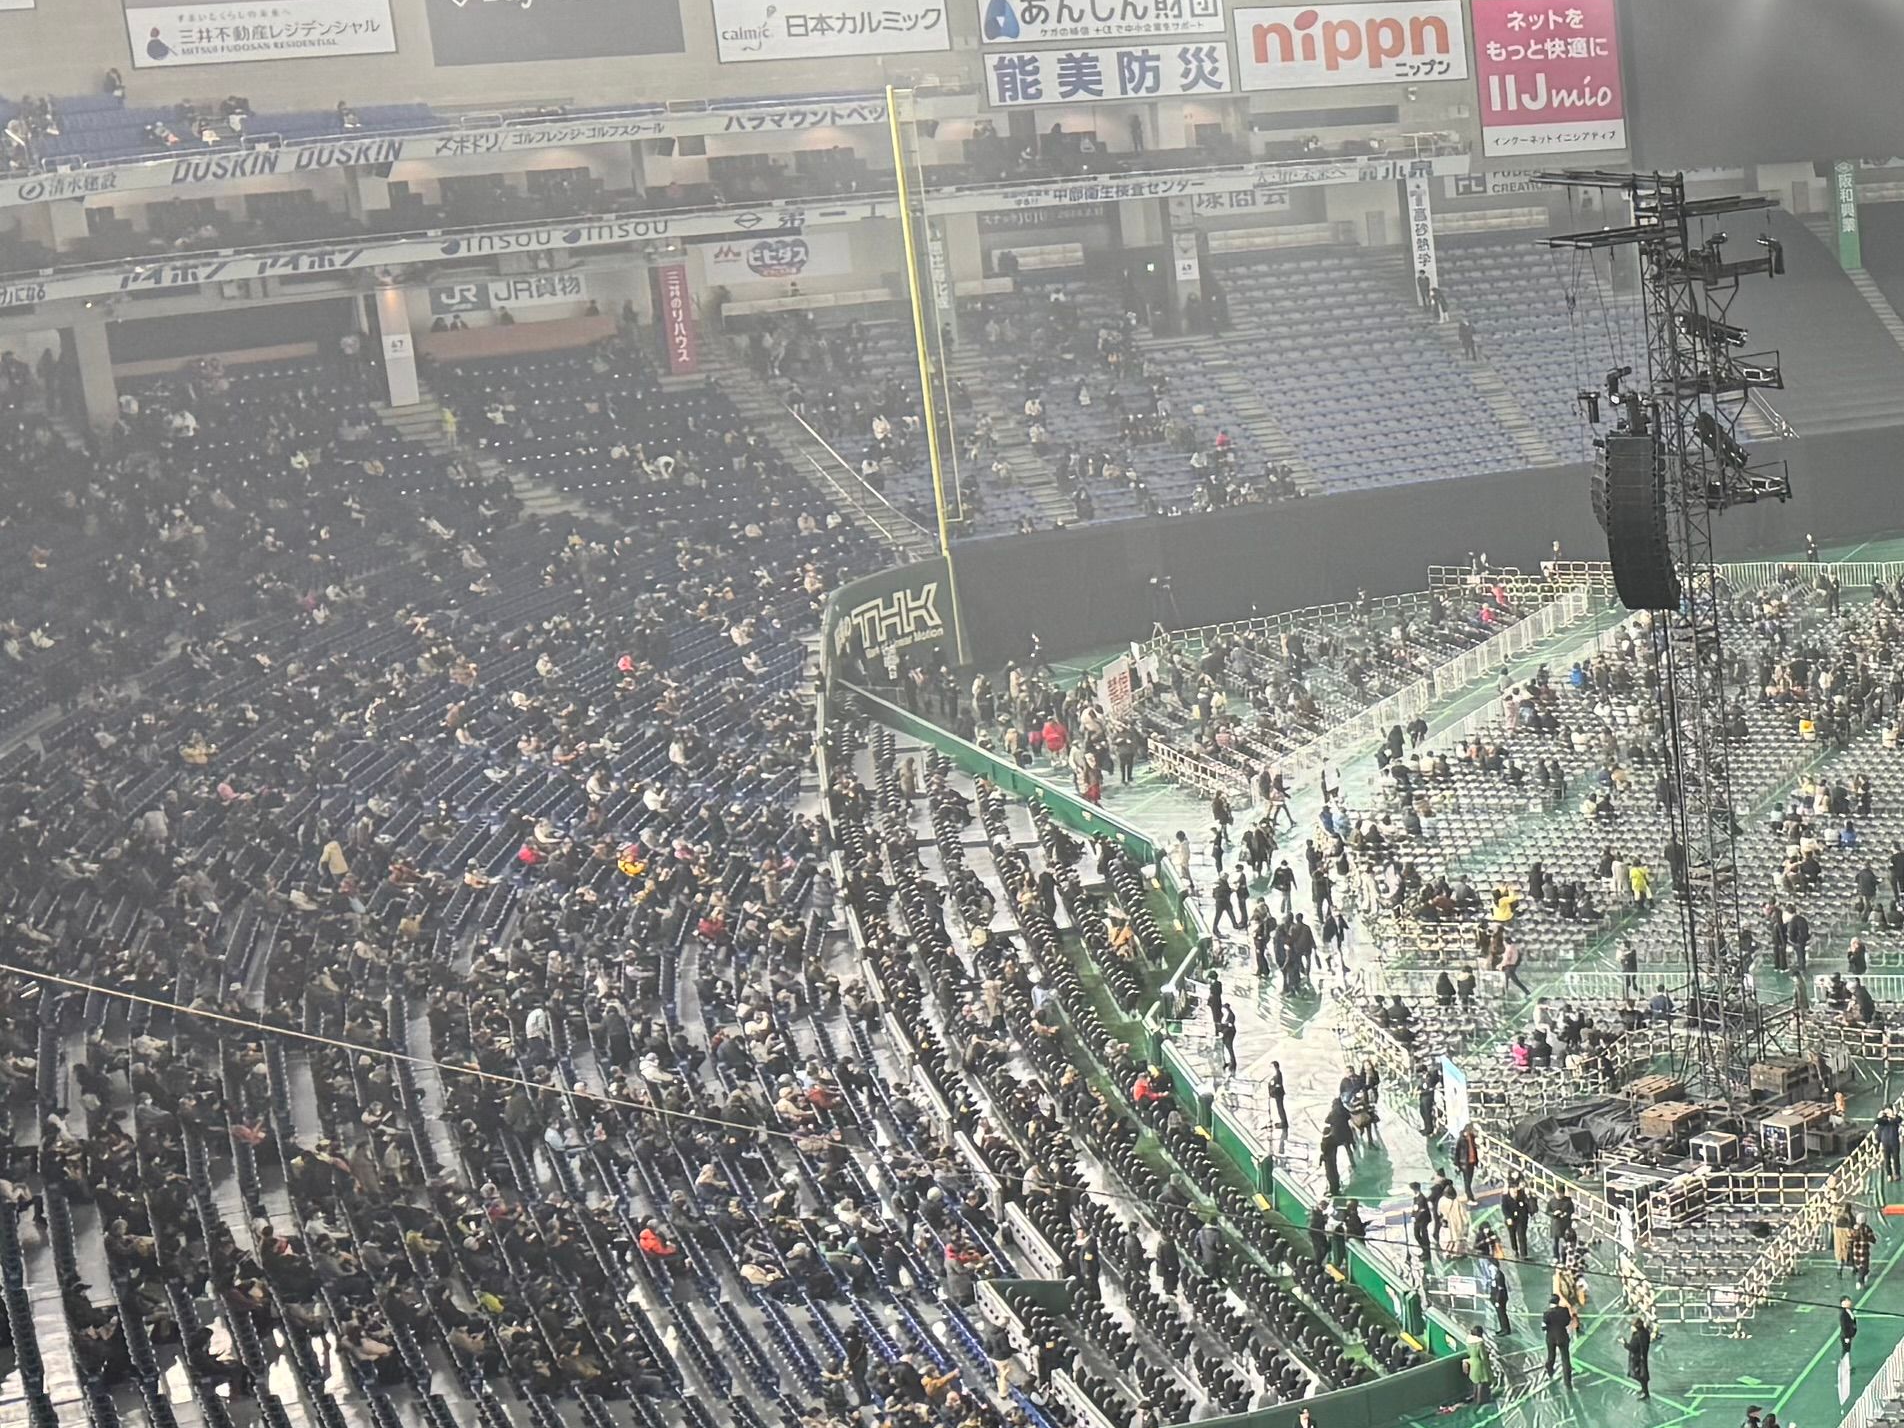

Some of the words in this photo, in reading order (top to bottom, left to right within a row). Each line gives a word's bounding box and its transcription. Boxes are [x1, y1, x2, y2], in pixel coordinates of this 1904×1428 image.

[179, 19, 380, 45] 三井不動産レジデンシャル
[786, 7, 941, 38] 日本カルミック
[1507, 8, 1583, 30] ネットを
[1253, 9, 1450, 71] nippn
[1486, 37, 1608, 62] もっと快適に
[993, 45, 1224, 103] 能美防災
[1395, 59, 1450, 77] ニップン
[1489, 73, 1612, 111] IIJmio
[441, 285, 477, 306] JR
[494, 275, 581, 302] JR貨物
[666, 271, 690, 362] 三井のリハウス
